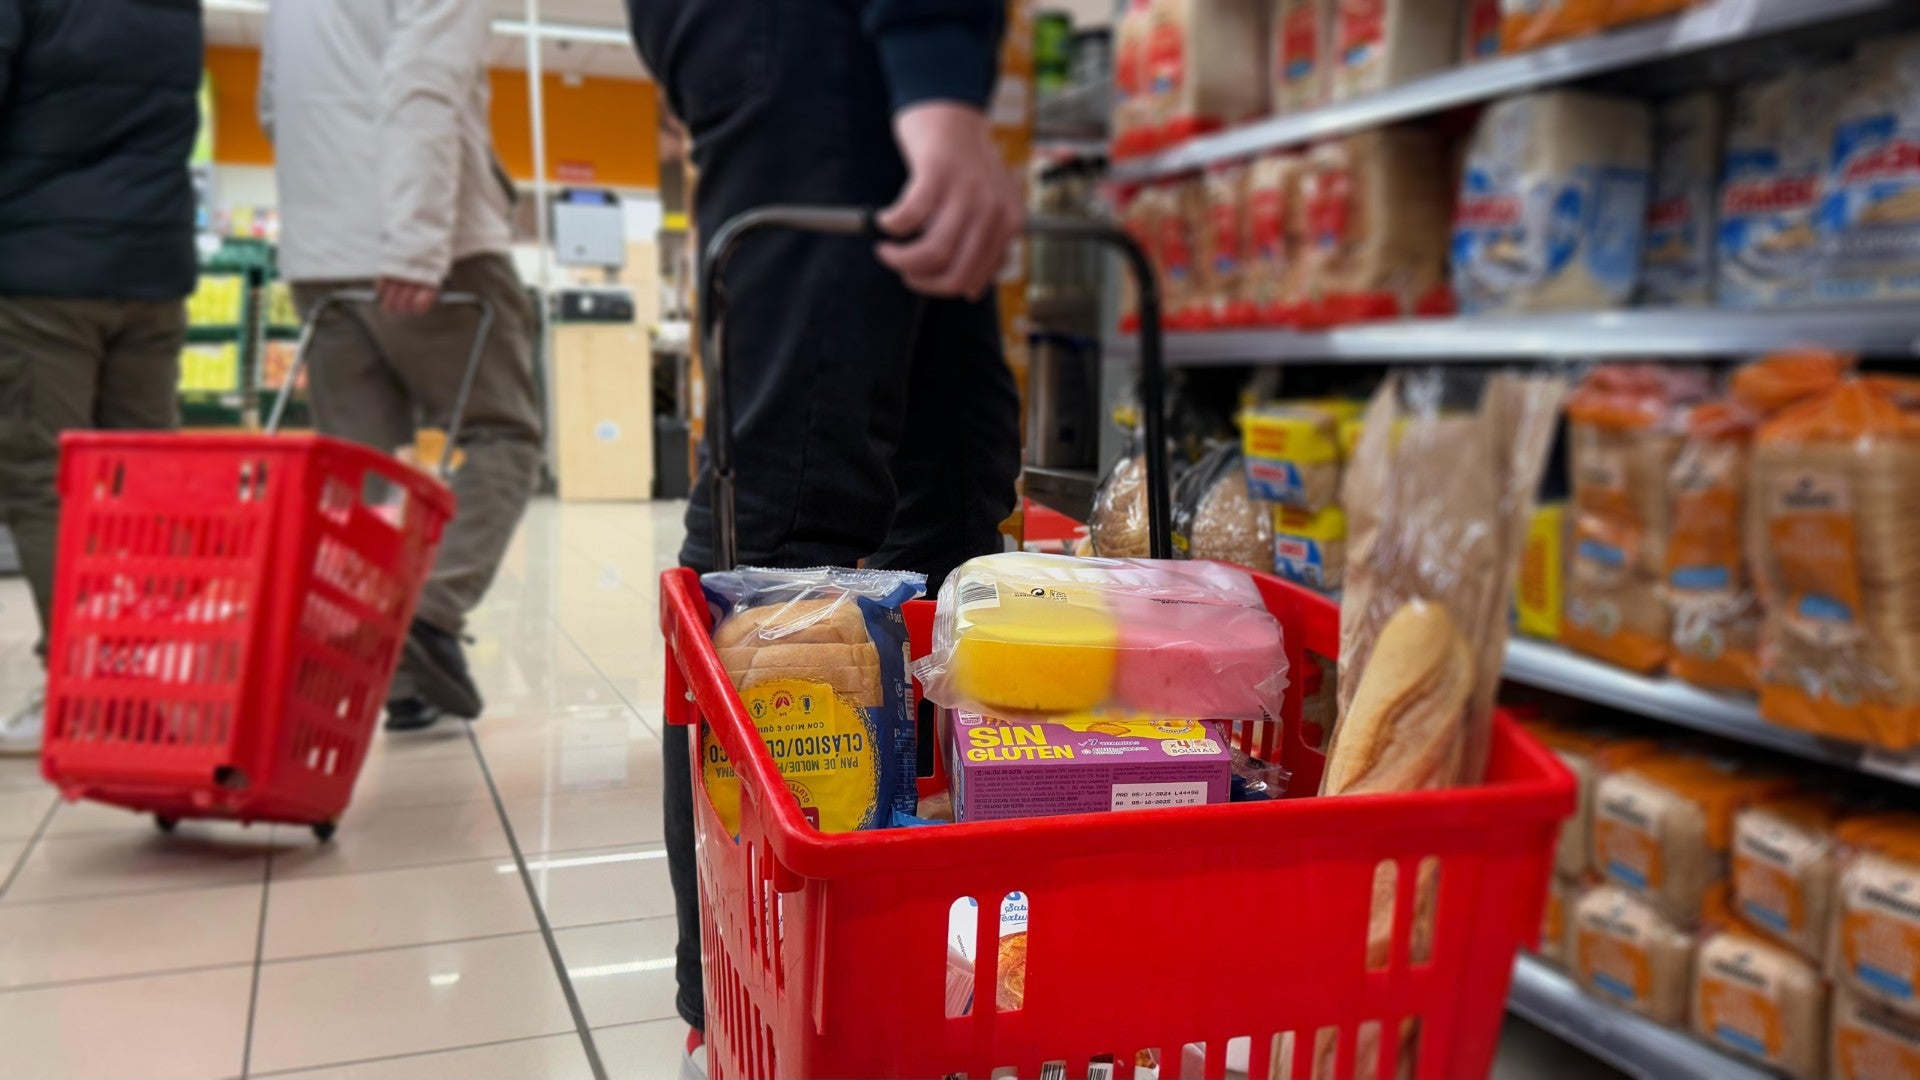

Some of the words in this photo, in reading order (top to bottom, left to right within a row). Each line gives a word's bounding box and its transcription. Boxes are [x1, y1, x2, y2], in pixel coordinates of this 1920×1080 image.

[785, 723, 805, 731] MIJO
[808, 721, 824, 730] CON
[968, 724, 1048, 748] SIN
[765, 732, 863, 758] CLÁSICO/CL
[1172, 747, 1215, 755] BOLSITAS
[967, 744, 1075, 762] GLUTEN
[775, 759, 819, 774] MOLDE/P
[824, 758, 836, 770] DE
[841, 756, 859, 769] PAN
[715, 766, 735, 779] RMA
[787, 783, 809, 803] GLUTE
[1005, 903, 1027, 913] Sab
